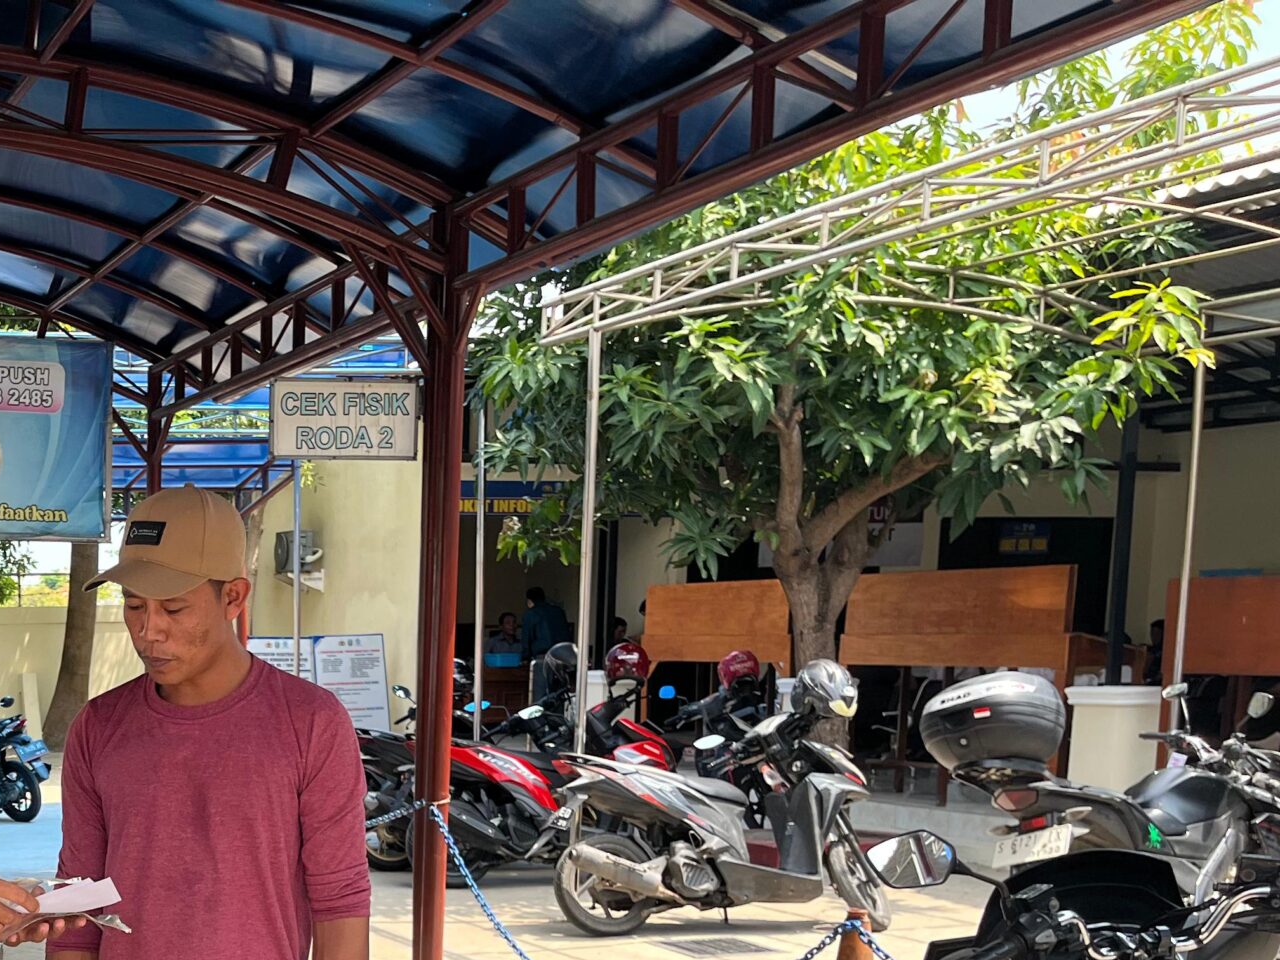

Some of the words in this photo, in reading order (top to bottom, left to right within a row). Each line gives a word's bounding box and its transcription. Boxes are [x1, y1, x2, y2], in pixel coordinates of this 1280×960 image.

[8, 388, 53, 408] 2485
[281, 392, 336, 416] CEK
[343, 392, 410, 416] FISIK
[296, 426, 373, 450] RODA
[378, 426, 393, 449] 2
